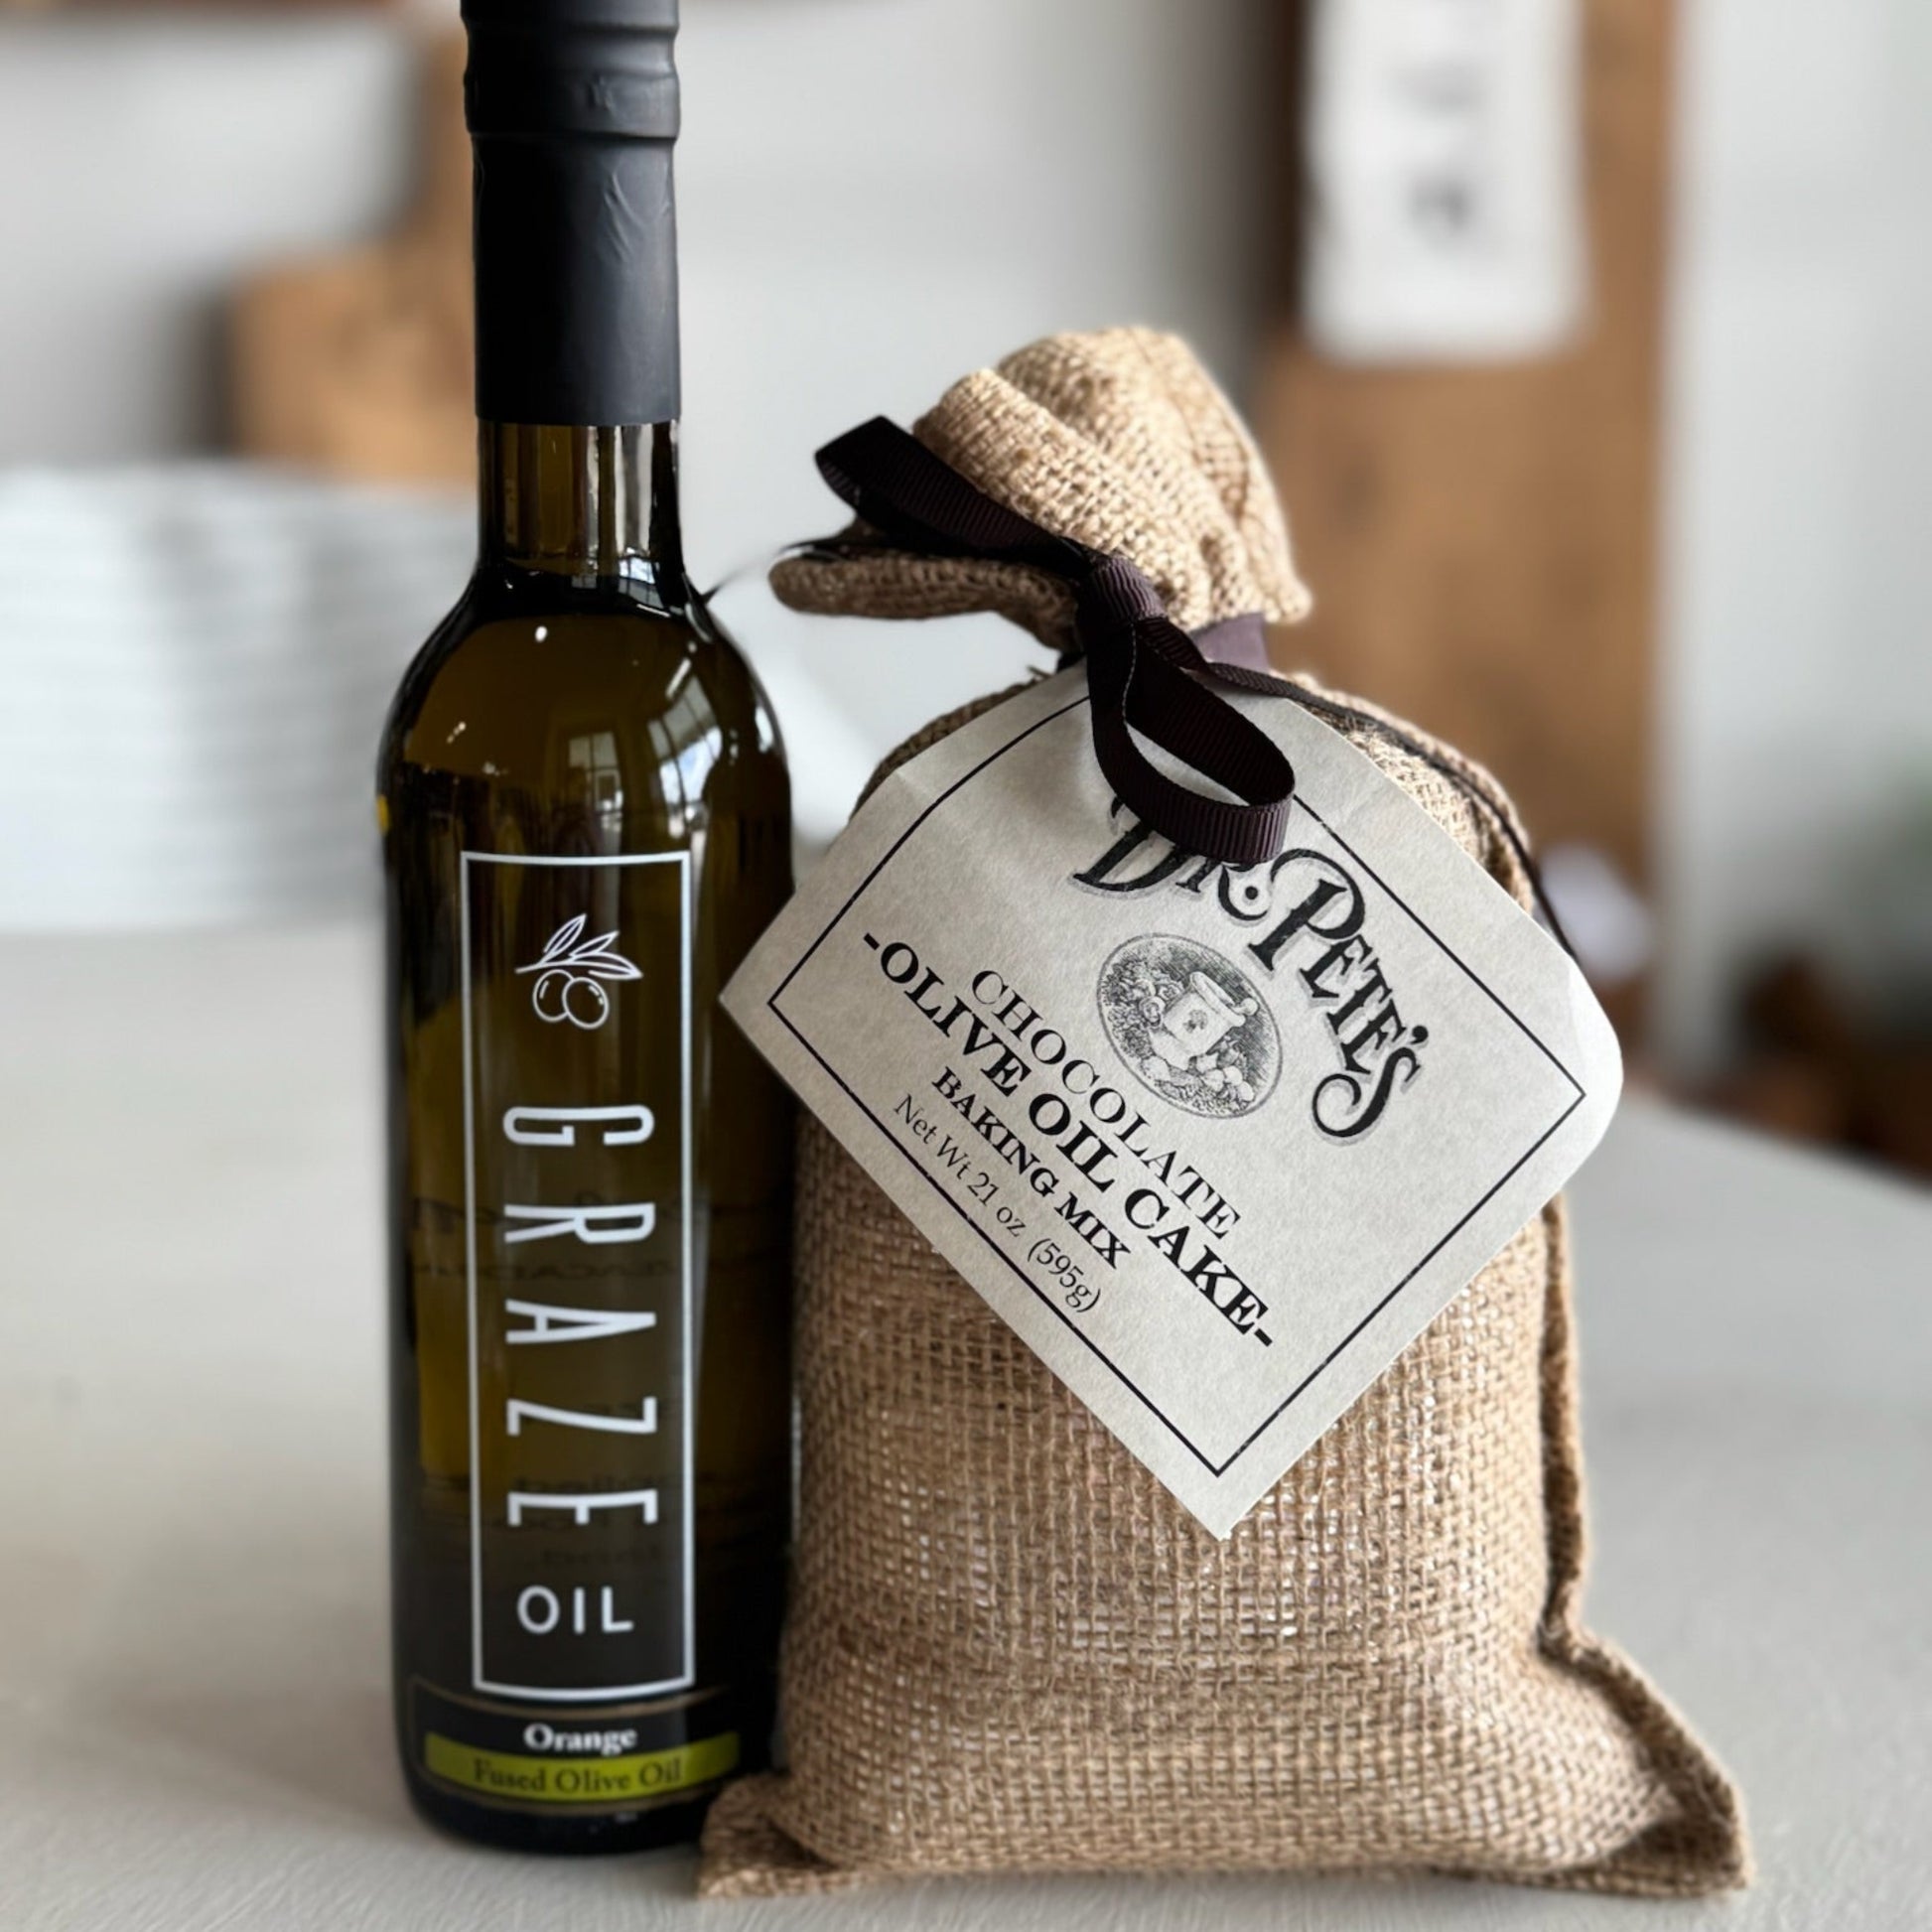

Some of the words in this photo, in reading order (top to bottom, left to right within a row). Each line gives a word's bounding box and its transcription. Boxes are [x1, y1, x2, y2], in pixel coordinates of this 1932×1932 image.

[863, 932, 1032, 1097] -OLIVE
[1029, 1093, 1115, 1192] OIL
[1124, 1188, 1273, 1347] CAKE-
[894, 1094, 936, 1145] Net
[936, 1133, 970, 1178] Wt
[967, 1172, 1000, 1207] 21
[997, 1205, 1027, 1237] oz
[1027, 1237, 1101, 1312] (595g)
[931, 1066, 1060, 1197] BAKING
[1054, 1192, 1131, 1269] MIX
[971, 970, 1241, 1239] CHOCOLATE
[503, 1105, 657, 1526] GRAZE
[517, 1586, 633, 1634] OIL
[473, 1757, 546, 1792] Fused
[554, 1767, 631, 1794] Olive
[638, 1756, 682, 1787] Oil
[523, 1723, 637, 1756] Orange
